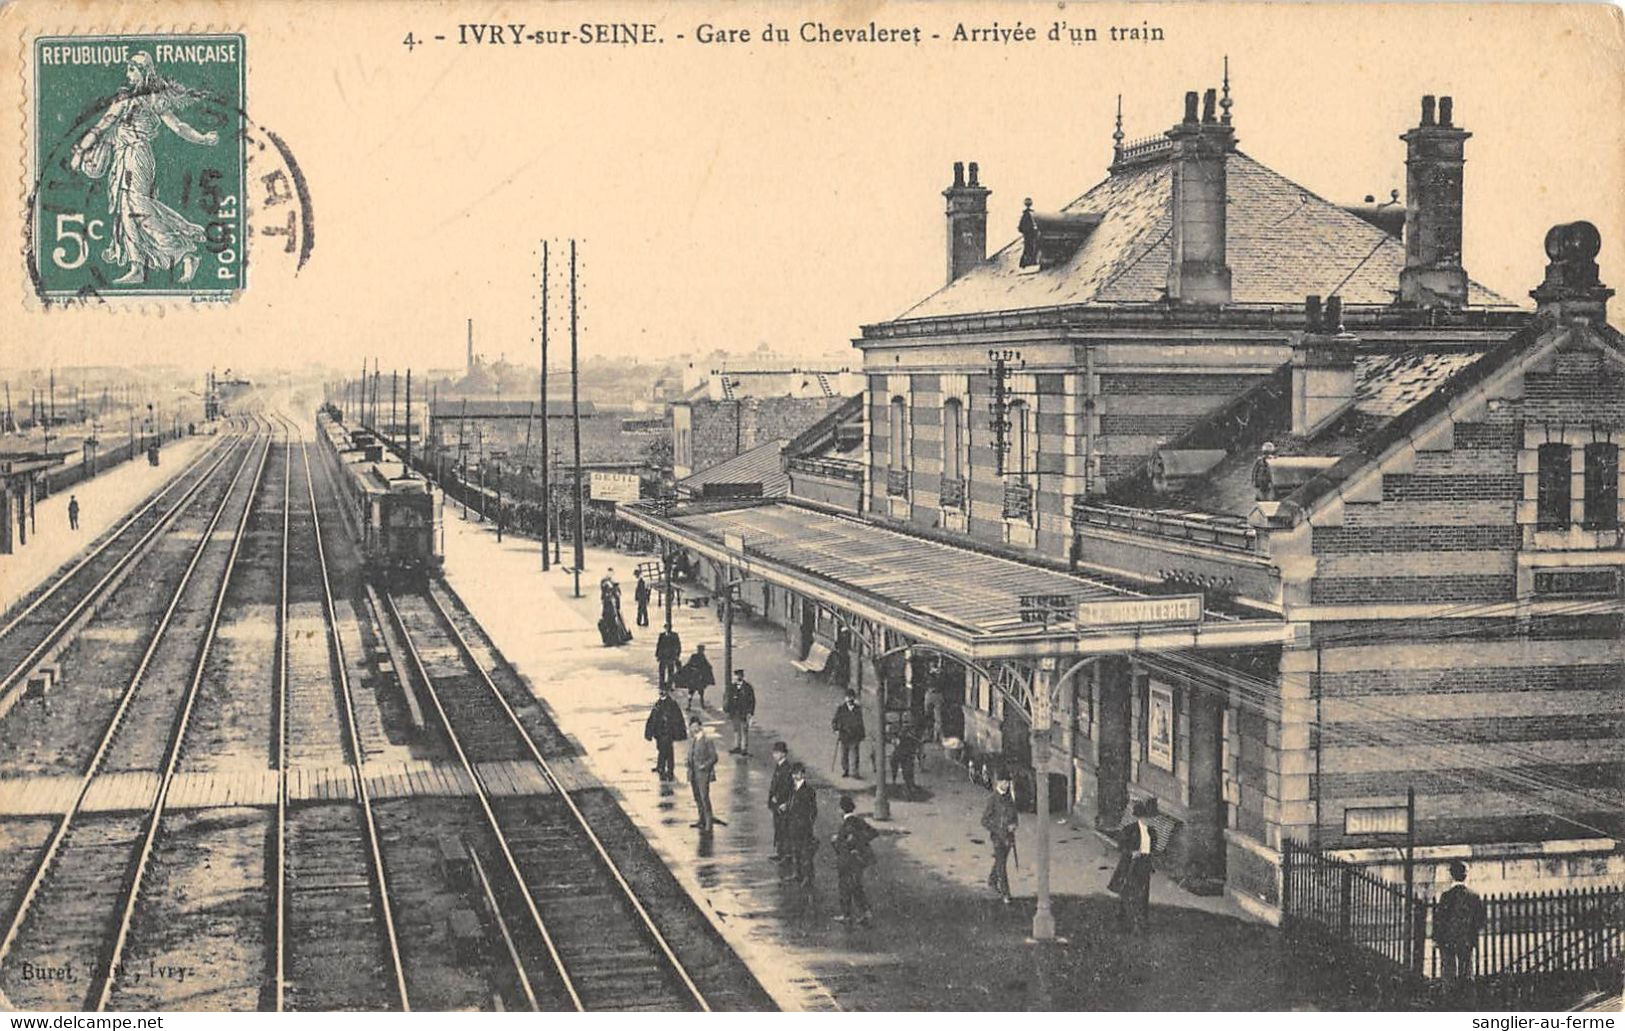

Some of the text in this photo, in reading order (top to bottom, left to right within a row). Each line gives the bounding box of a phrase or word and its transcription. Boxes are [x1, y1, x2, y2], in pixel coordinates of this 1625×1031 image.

[42, 44, 237, 67] REPUBLIQUE FRANÇAISE
[217, 195, 237, 279] POES
